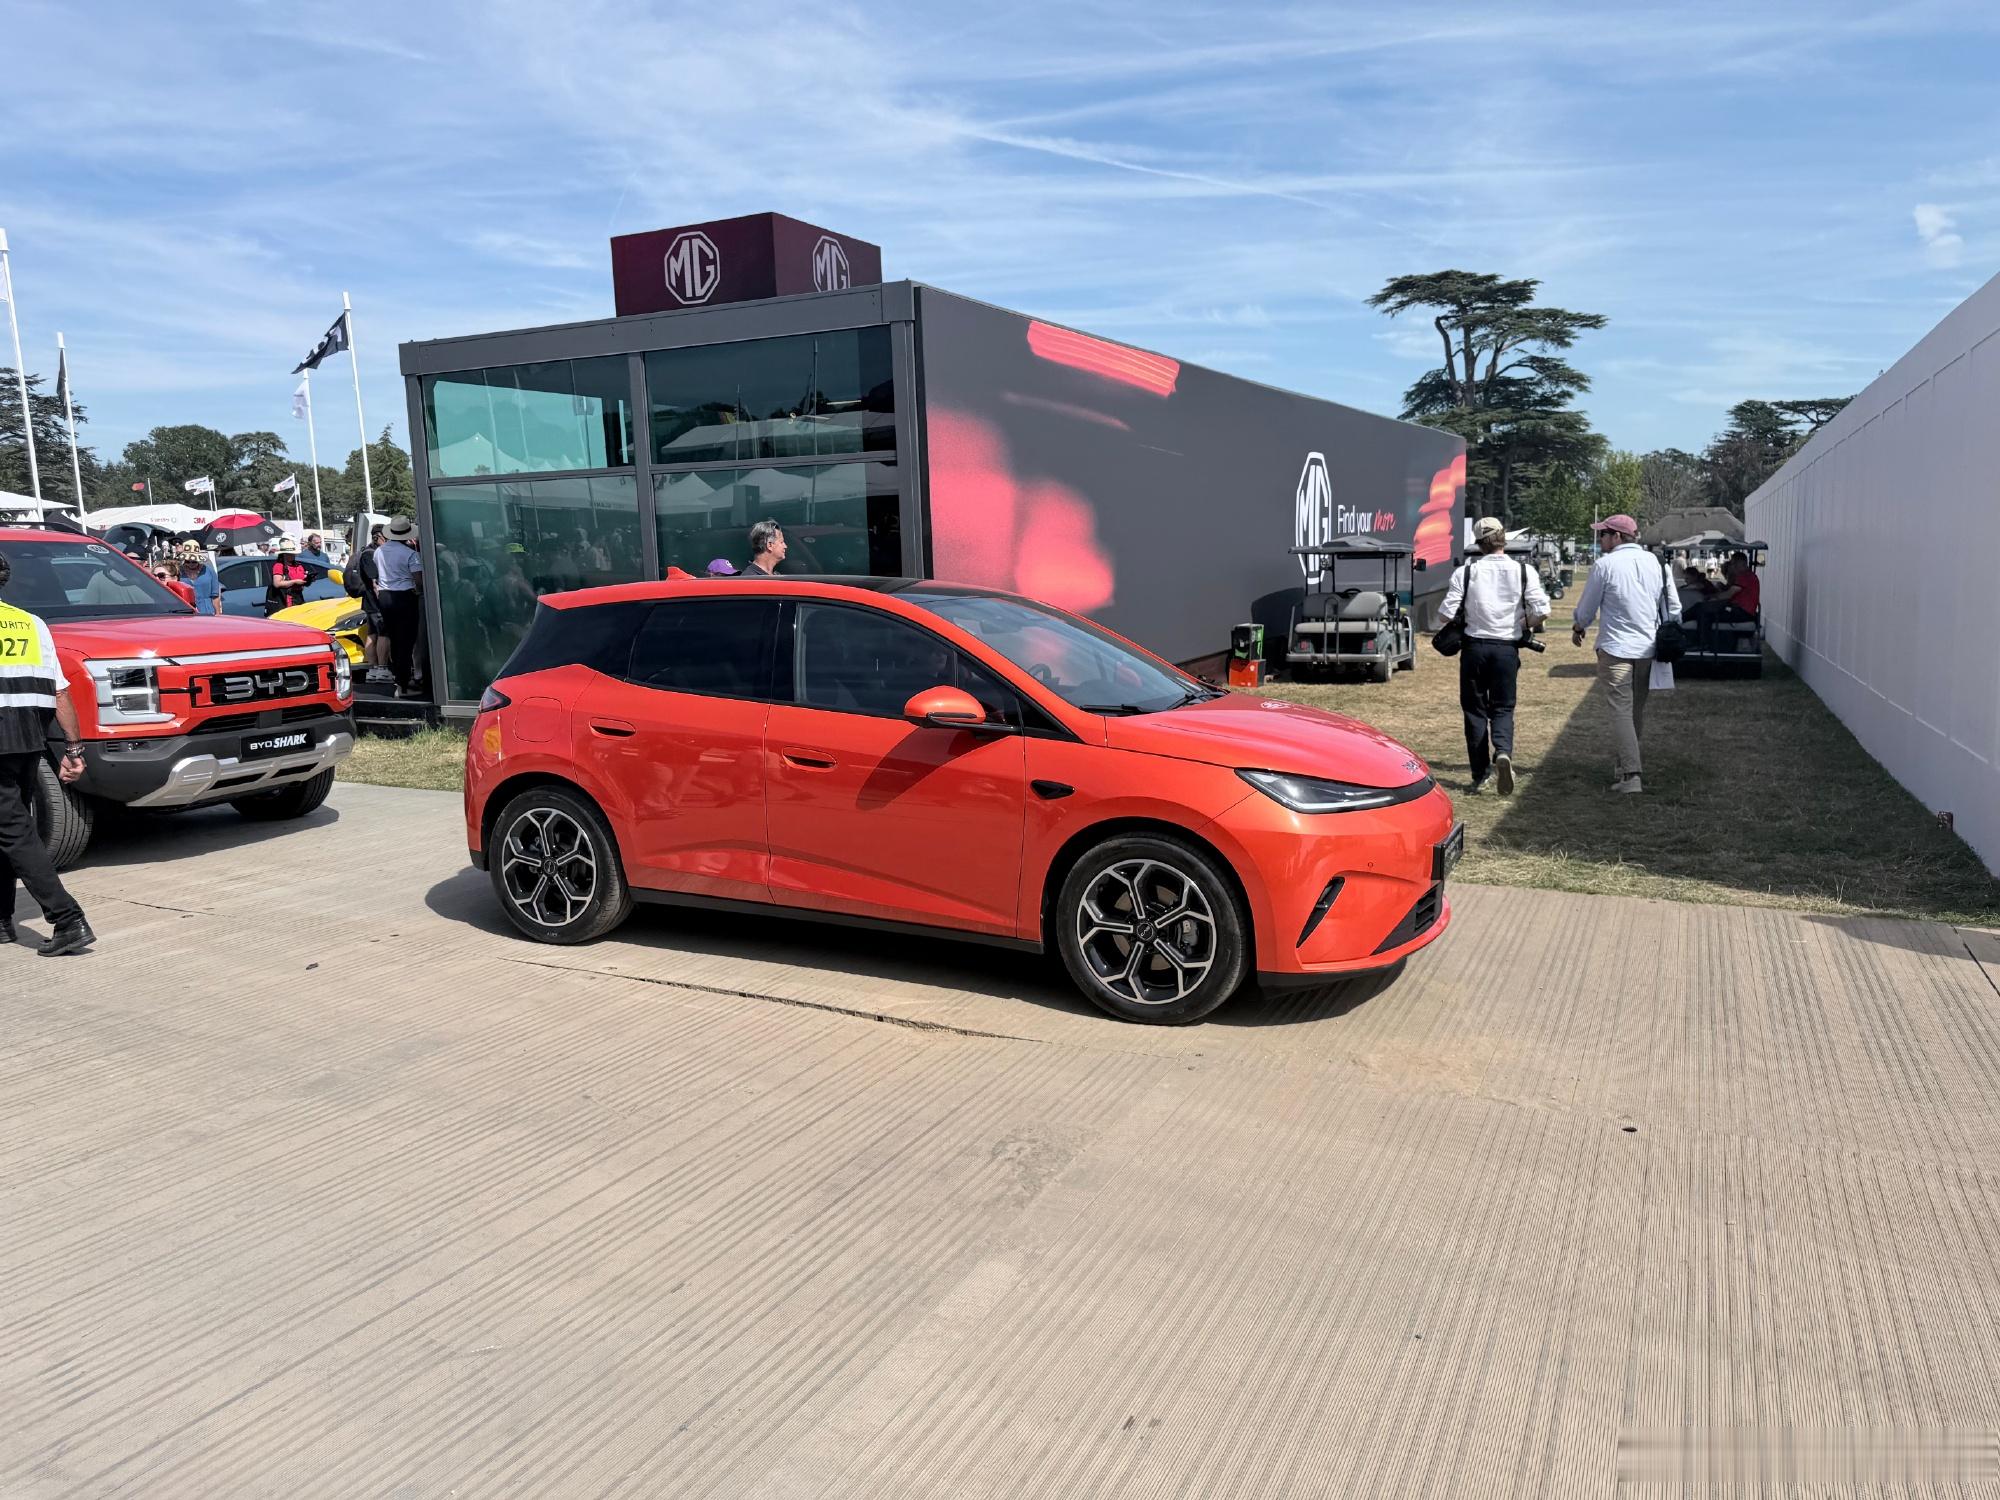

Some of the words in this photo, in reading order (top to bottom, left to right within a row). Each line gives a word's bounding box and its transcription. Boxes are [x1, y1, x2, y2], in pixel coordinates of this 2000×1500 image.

[668, 236, 716, 299] MG
[815, 242, 848, 293] MG
[1299, 463, 1330, 573] MG
[1337, 504, 1356, 534] Find
[1356, 510, 1373, 536] your
[224, 670, 310, 700] BYD
[250, 740, 273, 750] BYD
[273, 733, 308, 749] SHARK
